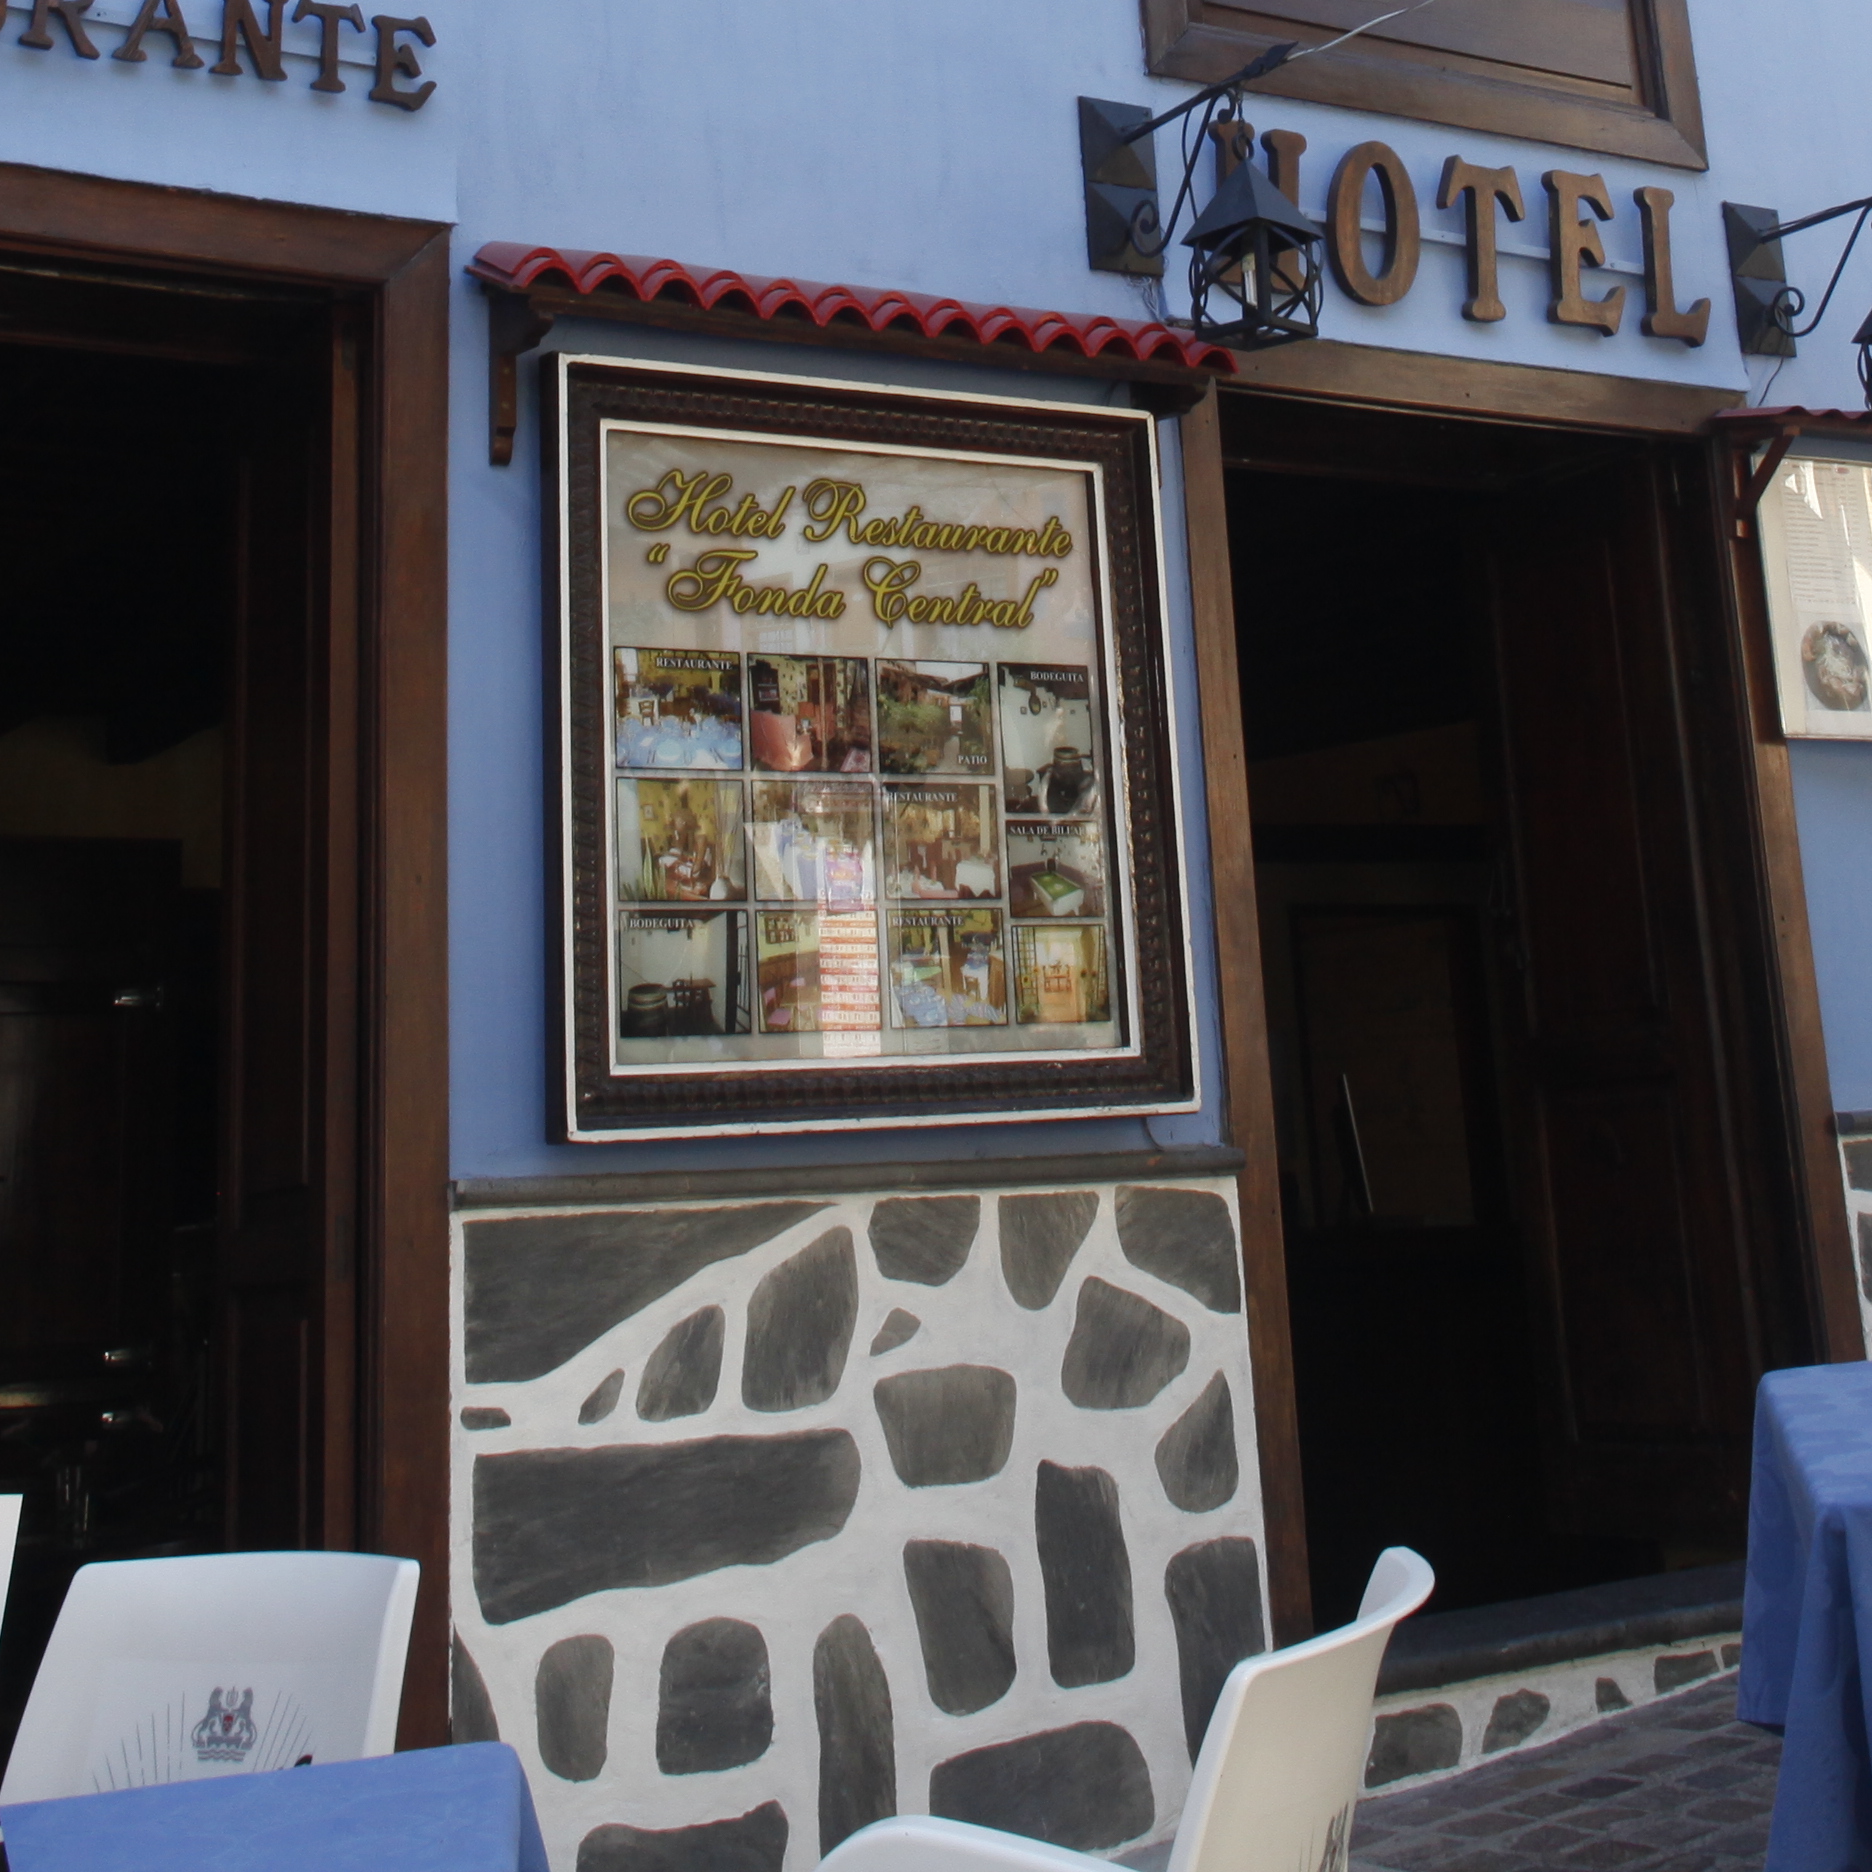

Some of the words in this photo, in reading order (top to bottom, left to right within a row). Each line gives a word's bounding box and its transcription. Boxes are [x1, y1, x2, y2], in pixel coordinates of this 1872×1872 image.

[628, 467, 796, 540] Hotel
[802, 478, 1073, 559] Restaurante
[656, 657, 733, 671] RESTAURANTE
[1030, 671, 1085, 683] BODEGUITA
[957, 755, 988, 766] PATIO
[886, 791, 958, 803] RESTAURANTE
[1036, 826, 1049, 836] DE
[629, 918, 694, 929] BODEGUITA
[892, 915, 964, 927] RESTAURANTE
